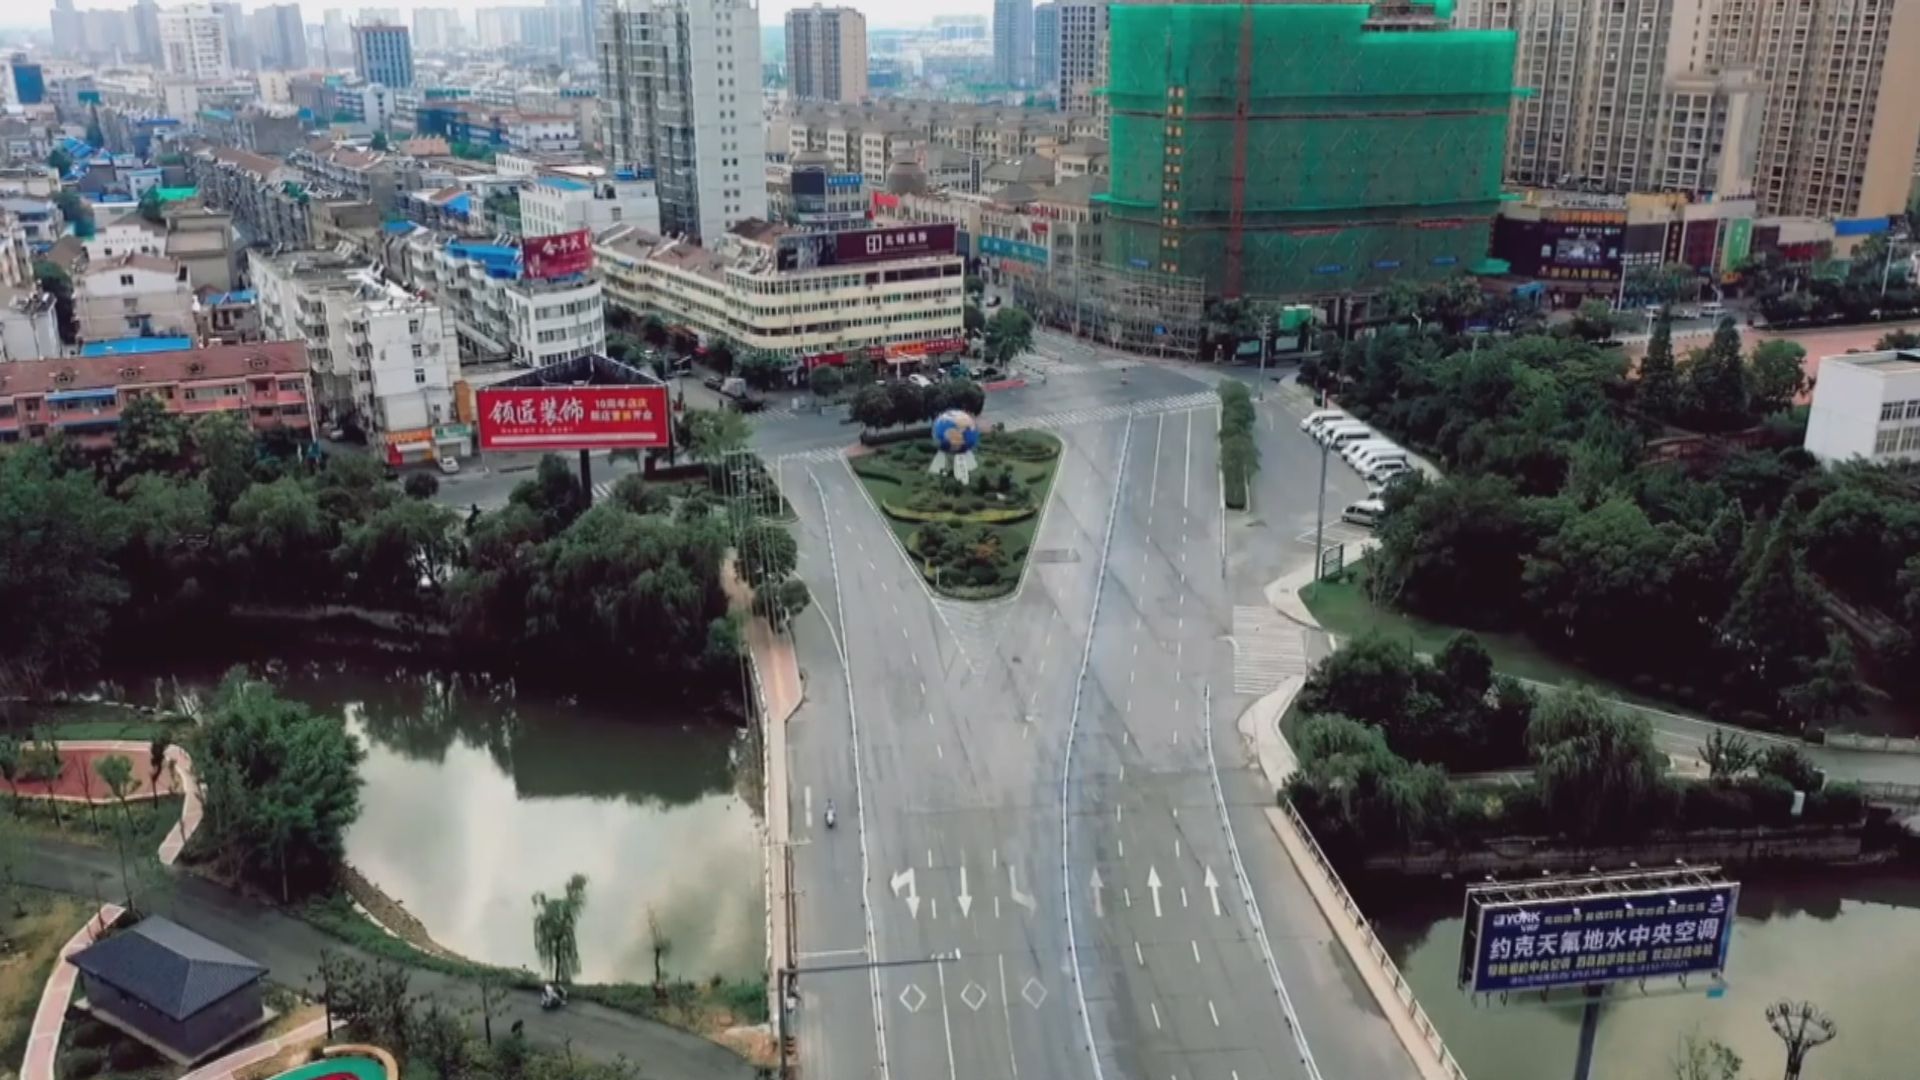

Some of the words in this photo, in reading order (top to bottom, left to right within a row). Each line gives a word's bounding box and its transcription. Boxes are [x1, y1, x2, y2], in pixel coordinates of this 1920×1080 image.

[488, 396, 584, 426] 领匠装饰
[1506, 910, 1541, 925] YORK
[1489, 918, 1719, 960] 约克天氟地水中央空调
